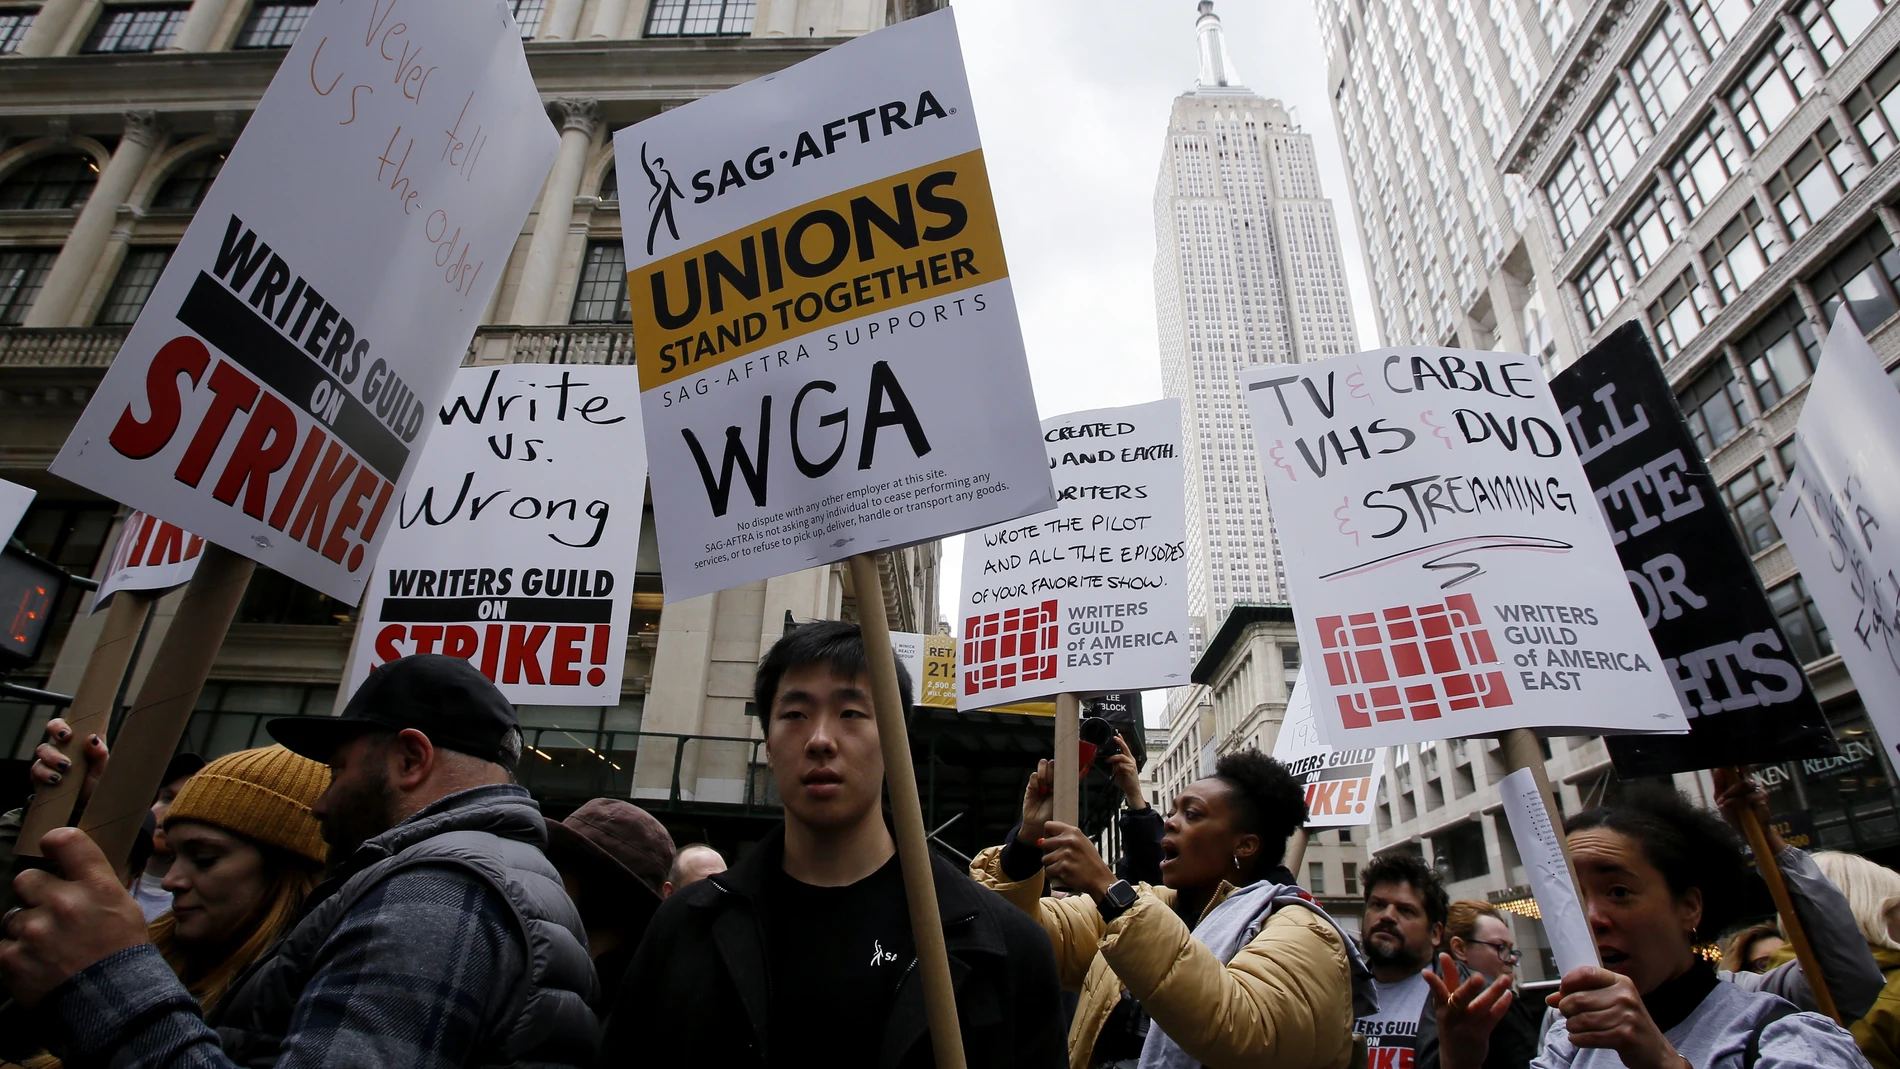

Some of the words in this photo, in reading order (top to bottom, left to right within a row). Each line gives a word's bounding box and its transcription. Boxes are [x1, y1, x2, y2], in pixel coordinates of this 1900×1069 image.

[441, 91, 487, 181] tell
[378, 126, 419, 215] the
[650, 170, 968, 331] UNIONS
[659, 311, 767, 374] STAND
[773, 247, 981, 331] TOGETHER
[213, 213, 370, 385] WRITERS
[362, 357, 425, 444] GUILD
[663, 344, 810, 408] SAG-AFTRA
[828, 293, 987, 351] SUPPORTS
[310, 380, 346, 426] ON
[439, 369, 627, 426] Write
[1248, 370, 1335, 427] TV
[1383, 354, 1536, 399] CABLE
[681, 360, 932, 518] WGA
[1044, 422, 1136, 443] CREATED
[1294, 417, 1417, 478] VHS
[1451, 408, 1563, 458] DVD
[109, 335, 395, 573] STRIKE!
[1062, 450, 1116, 467] AND
[1121, 444, 1179, 463] EARTH.
[399, 471, 610, 548] Wrong
[705, 533, 754, 553] SAG-AFTRA
[756, 530, 764, 540] is
[765, 526, 780, 537] not
[782, 517, 809, 533] asking
[811, 513, 825, 526] any
[826, 499, 870, 520] individual
[872, 497, 882, 507] to
[884, 491, 912, 504] cease
[914, 476, 971, 499] performing
[973, 472, 991, 485] any
[737, 522, 750, 532] No
[752, 513, 784, 528] dispute
[785, 507, 804, 519] with
[805, 501, 820, 513] any
[821, 494, 844, 507] other
[846, 481, 891, 500] employer
[893, 479, 903, 489] at
[905, 473, 924, 485] this
[926, 469, 947, 481] site.
[1363, 473, 1577, 538] STREAMING
[694, 554, 730, 570] services,
[731, 551, 741, 560] or
[742, 547, 751, 556] to
[753, 539, 780, 554] refuse
[782, 536, 792, 546] to
[793, 529, 811, 546] pick
[813, 527, 826, 539] up,
[826, 517, 857, 533] deliver,
[858, 506, 891, 523] handle
[893, 504, 904, 514] or
[906, 493, 953, 513] transport
[955, 490, 974, 502] any
[976, 481, 1010, 499] goods.
[984, 524, 1041, 548] WROTE
[1044, 517, 1085, 534] THE
[1092, 514, 1152, 532] PILOT
[984, 554, 1022, 575] AND
[1028, 549, 1066, 565] ALL
[1068, 545, 1114, 563] THE
[1121, 541, 1185, 563] EPISODES
[388, 567, 514, 597] WRITERS
[521, 568, 615, 598] GUILD
[992, 584, 1029, 603] YOUR
[1031, 575, 1104, 595] FAVORITE
[1107, 575, 1168, 590] SHOW.
[477, 600, 508, 621] ON
[1067, 601, 1149, 620] WRITERS
[1067, 619, 1124, 636] GUILD
[1493, 604, 1599, 626] WRITERS
[1067, 636, 1085, 651] of
[1090, 631, 1179, 650] AMERICA
[1504, 626, 1578, 646] GUILD
[1067, 652, 1115, 668] EAST
[1513, 648, 1538, 668] of
[1547, 649, 1652, 673] AMERICA
[927, 681, 949, 689] 2,500
[1519, 671, 1582, 691] EAST
[1286, 753, 1326, 776] RITERS
[1328, 748, 1376, 767] GUILD
[1306, 771, 1321, 784] ON
[1366, 1036, 1381, 1047] ON
[1385, 1021, 1418, 1035] GUIL
